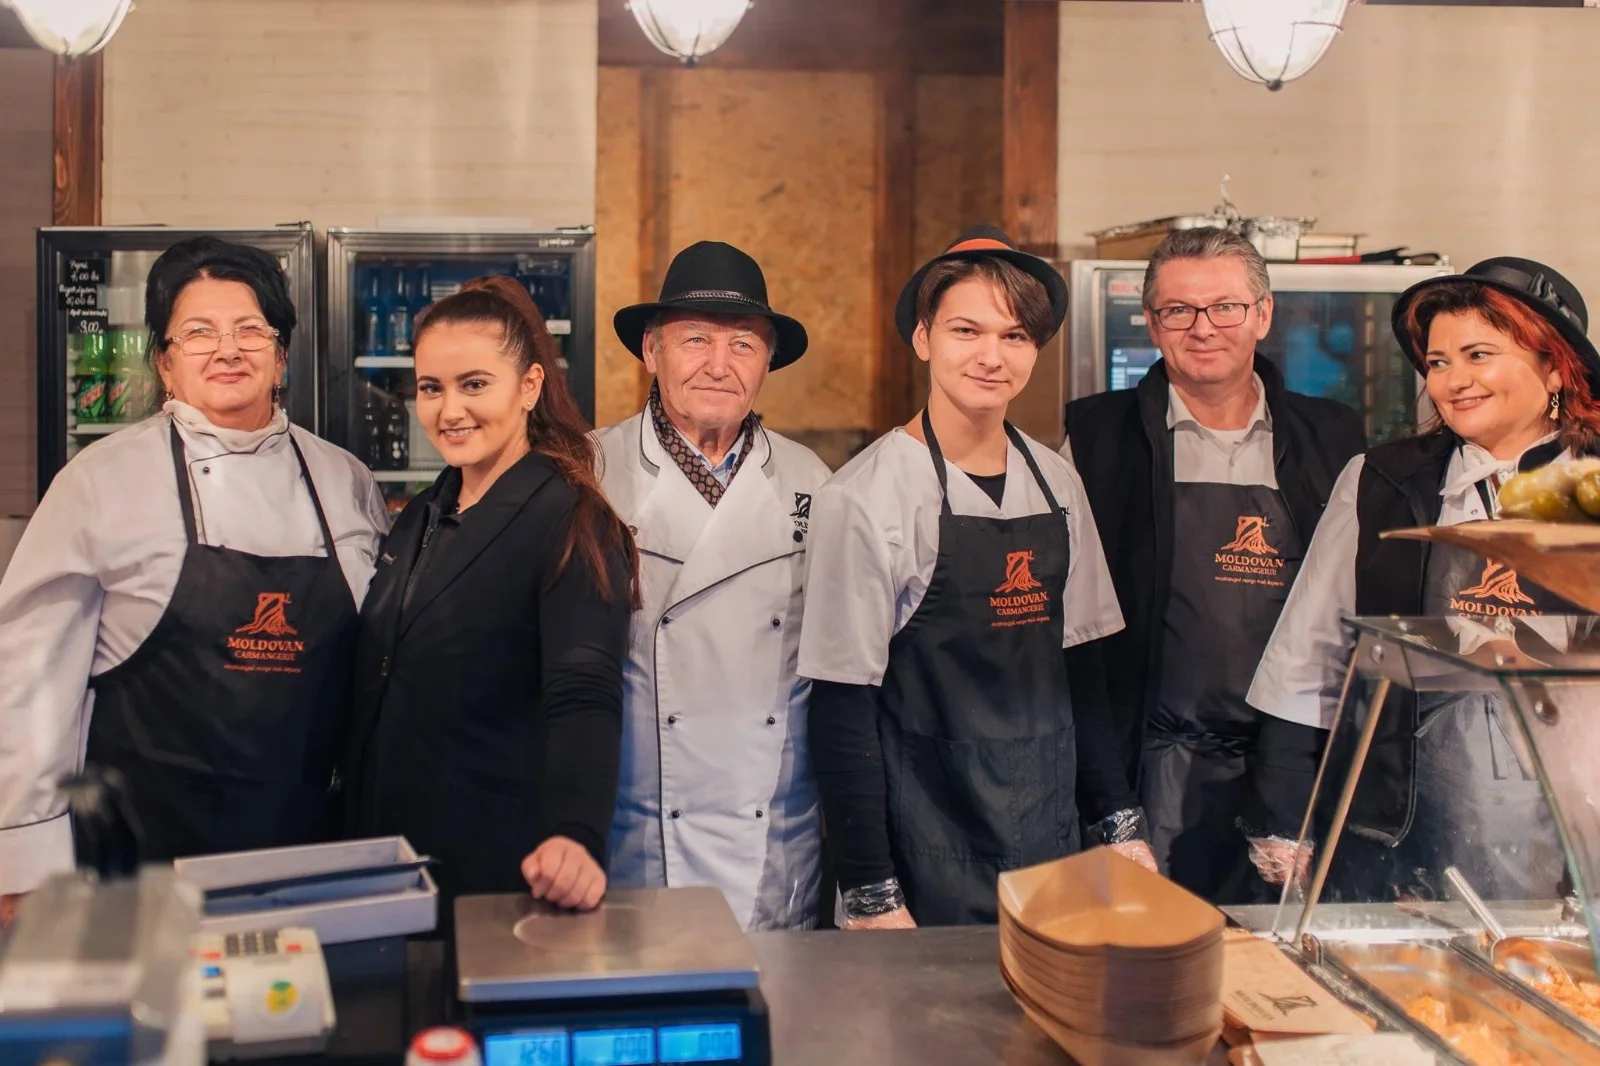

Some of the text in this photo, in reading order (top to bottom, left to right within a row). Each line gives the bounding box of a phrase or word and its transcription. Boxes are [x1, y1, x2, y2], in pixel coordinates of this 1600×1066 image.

[1214, 553, 1285, 568] MOLDOVAN
[1222, 564, 1277, 575] CARMANGERIE
[989, 591, 1048, 607] MOLDOVAN
[996, 603, 1045, 616] CARMANGERIE
[227, 636, 304, 652] MOLDOVAN
[234, 650, 296, 661] CARMANGERIE
